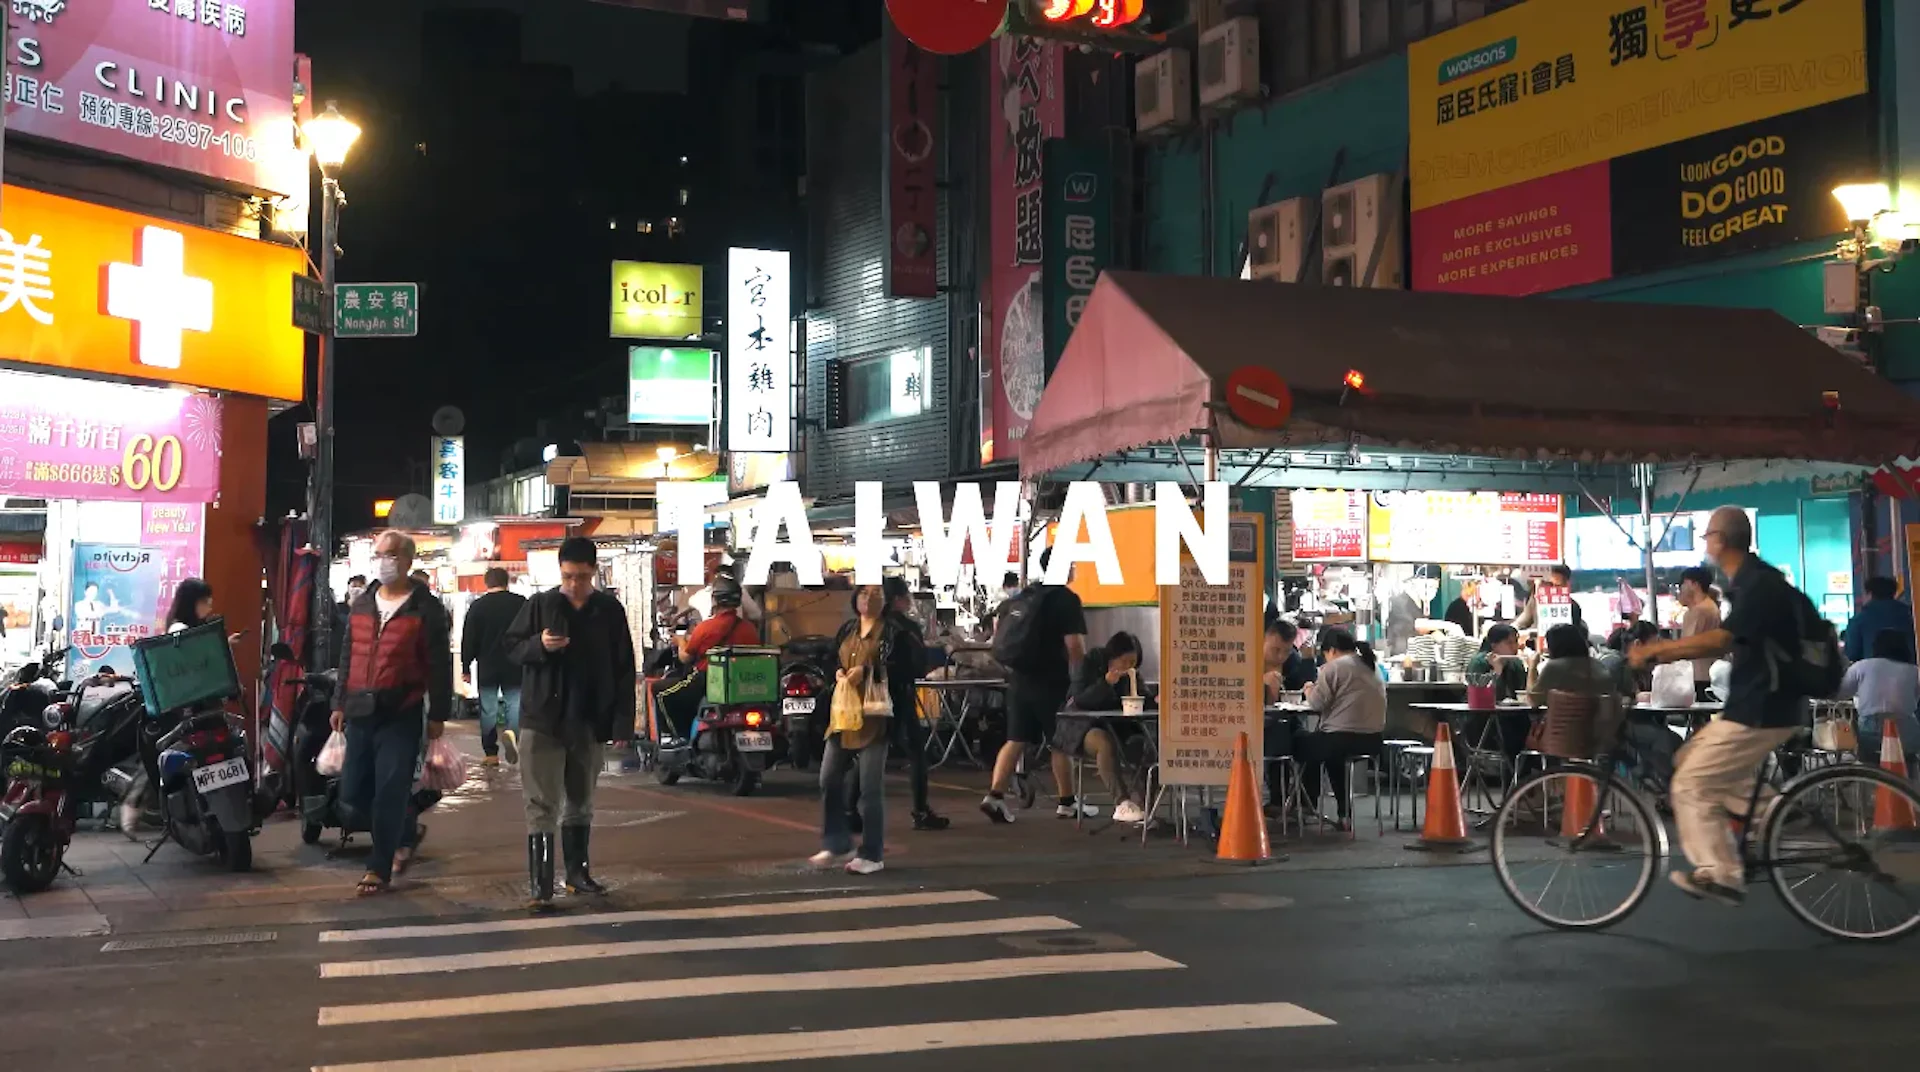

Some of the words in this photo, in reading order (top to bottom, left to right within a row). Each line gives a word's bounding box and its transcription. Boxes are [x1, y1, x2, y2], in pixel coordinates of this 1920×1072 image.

[1446, 44, 1507, 77] watsons
[95, 61, 246, 124] CLINIC
[1436, 53, 1576, 126] 屈臣氏寵i會員
[1681, 160, 1712, 183] LOOK
[1711, 135, 1786, 176] GOOD
[1681, 182, 1733, 220] DO
[1734, 166, 1785, 205] GOOD
[1441, 245, 1481, 264] MORE
[1485, 223, 1573, 253] EXCLUSIVES
[1453, 220, 1493, 240] MORE
[1497, 205, 1559, 229] SAVINGS
[1682, 225, 1710, 248] FEEL
[1708, 203, 1789, 244] GREAT
[0, 228, 54, 325] 美
[1437, 265, 1476, 285] MORE
[1480, 243, 1579, 275] EXPERIENCES
[344, 289, 409, 310] 農安街
[620, 281, 695, 306] icolr
[744, 266, 775, 438] 宮本雞肉
[28, 414, 123, 450] 滿千折百
[147, 520, 170, 534] New
[172, 519, 197, 534] Year
